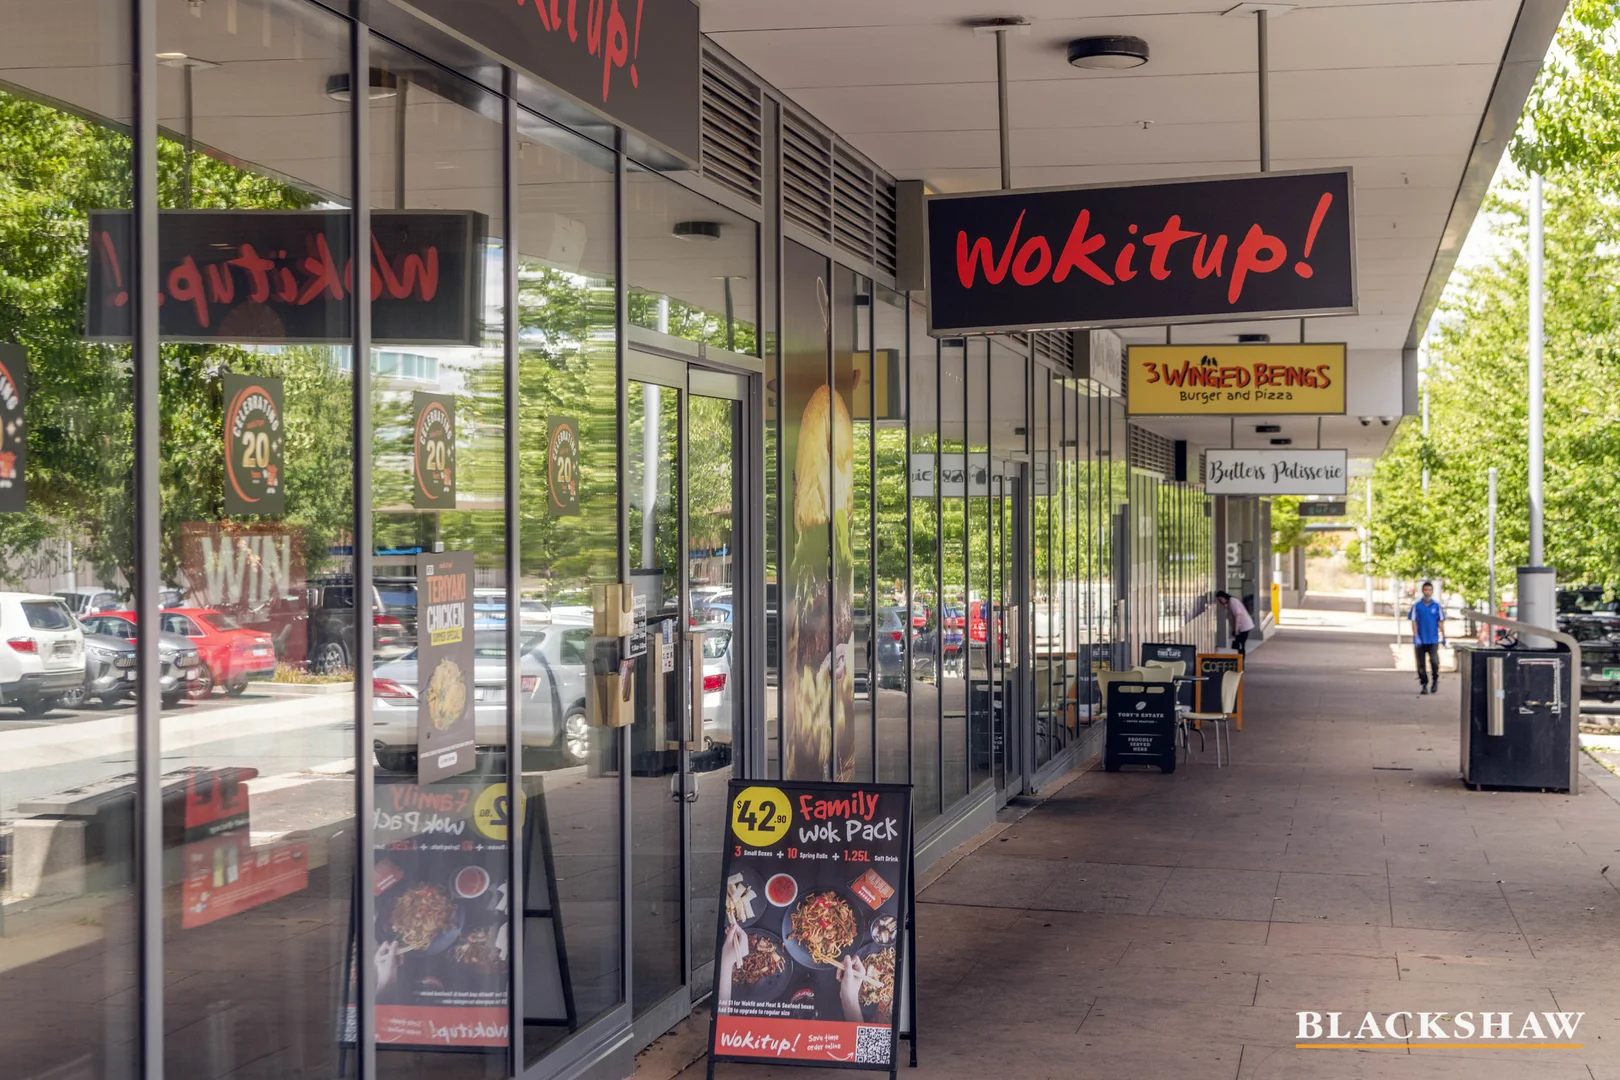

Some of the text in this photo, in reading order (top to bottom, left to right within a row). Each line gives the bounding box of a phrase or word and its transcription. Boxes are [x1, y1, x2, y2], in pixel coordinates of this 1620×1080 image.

[956, 192, 1332, 304] Wokitup!
[1142, 359, 1331, 389] 3 WINGED BEINGS
[1179, 389, 1293, 404] Burger and Pizza
[232, 395, 279, 437] CELEBRATING
[242, 431, 270, 468] 20
[426, 440, 446, 471] 20
[557, 456, 571, 483] 20
[1209, 460, 1342, 483] Butters Patisserie
[201, 535, 291, 605] WIN
[426, 573, 467, 604] TERIYAKI
[427, 602, 465, 634] CHICKEN
[799, 790, 879, 821] Family
[846, 817, 899, 842] Pack
[734, 845, 742, 857] 3
[787, 848, 798, 859] 10
[844, 850, 870, 862] 1.25L
[720, 1030, 801, 1056] Wokitup!
